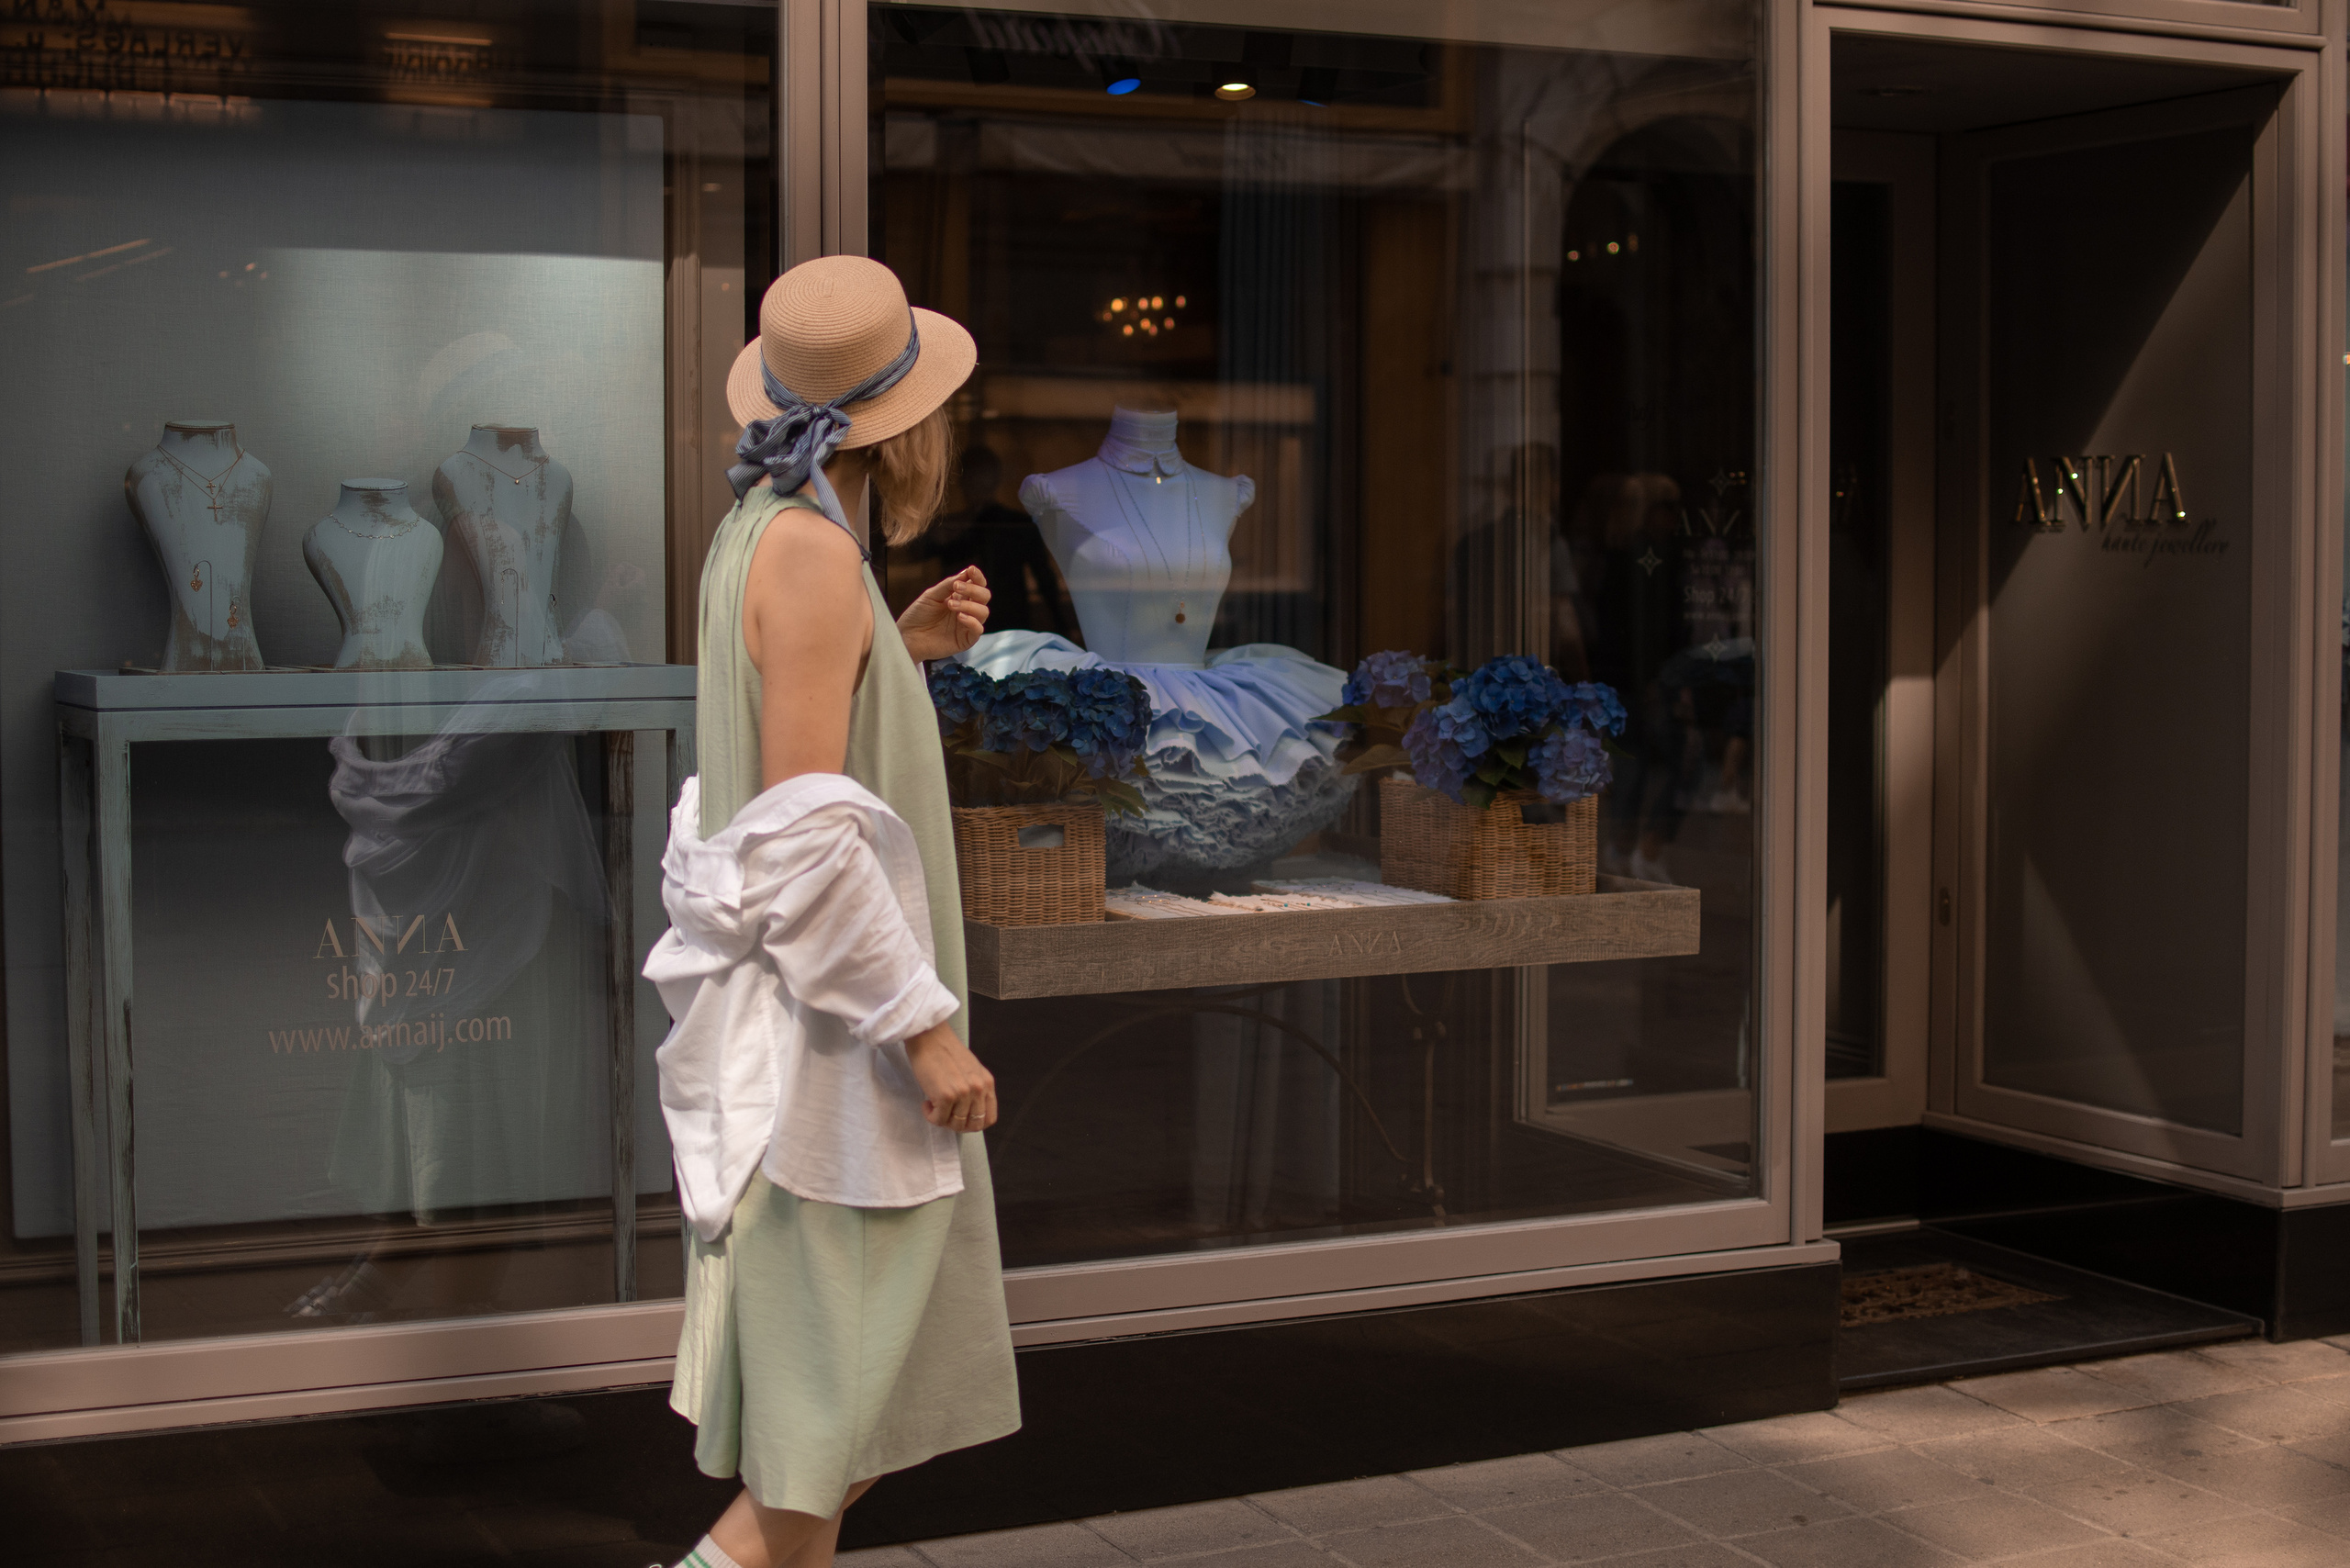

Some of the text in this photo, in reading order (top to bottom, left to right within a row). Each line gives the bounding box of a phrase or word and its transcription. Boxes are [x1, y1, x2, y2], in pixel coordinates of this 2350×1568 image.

[326, 965, 456, 1008] shop 24/7
[268, 1012, 512, 1054] www.annaij.com
